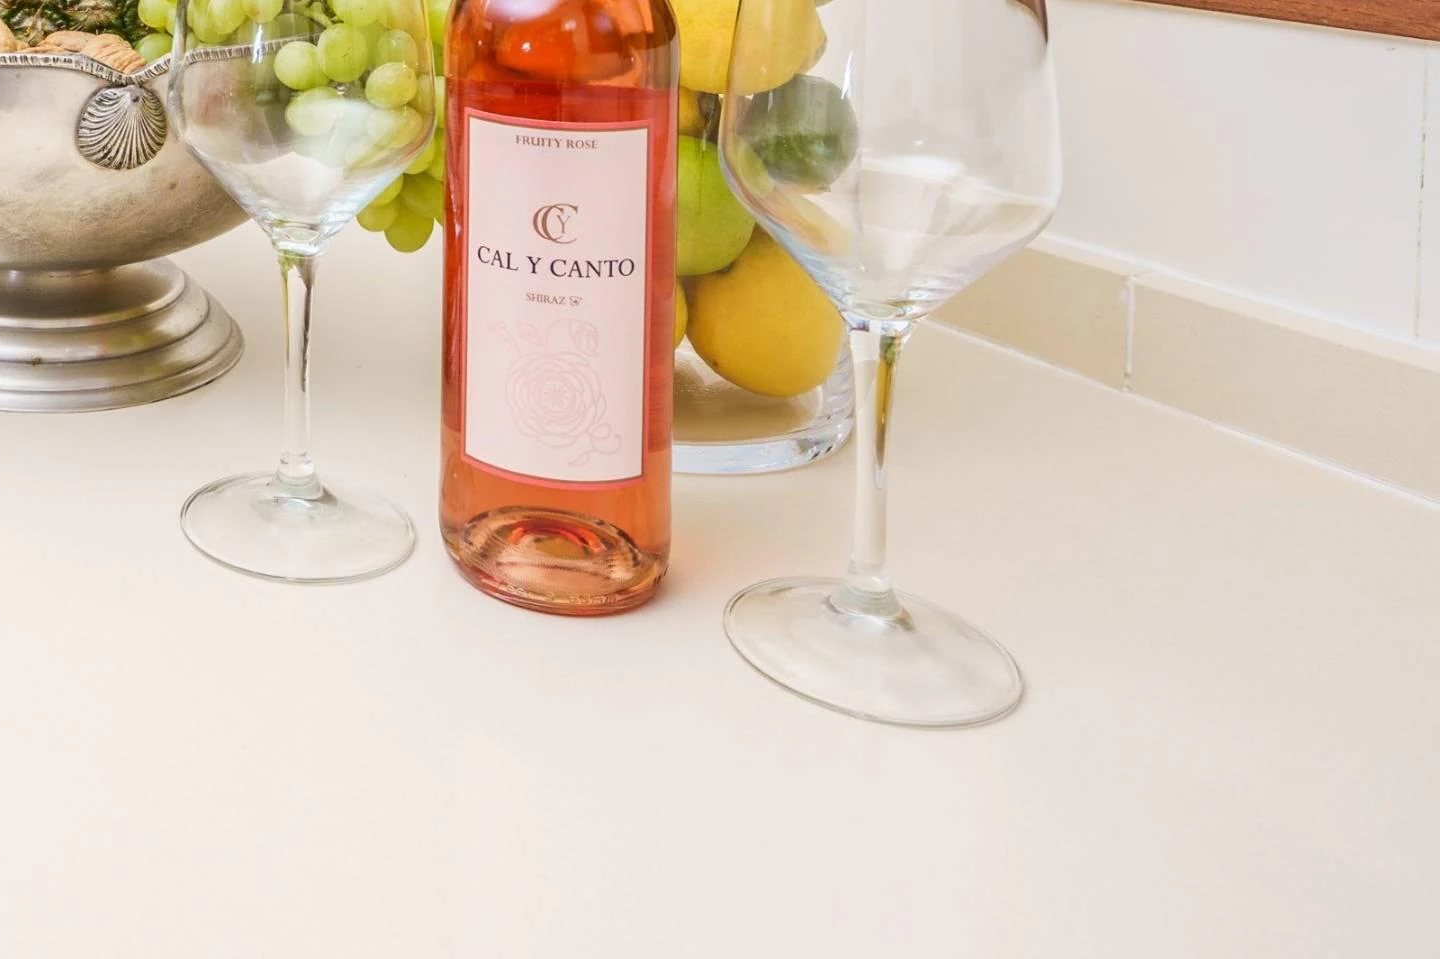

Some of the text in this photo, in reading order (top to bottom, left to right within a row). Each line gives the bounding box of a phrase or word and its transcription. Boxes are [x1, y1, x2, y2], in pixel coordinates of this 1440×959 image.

[515, 134, 561, 148] FRUITY
[477, 245, 635, 278] CAL Y CANTO
[526, 292, 567, 305] SHIRAZ
